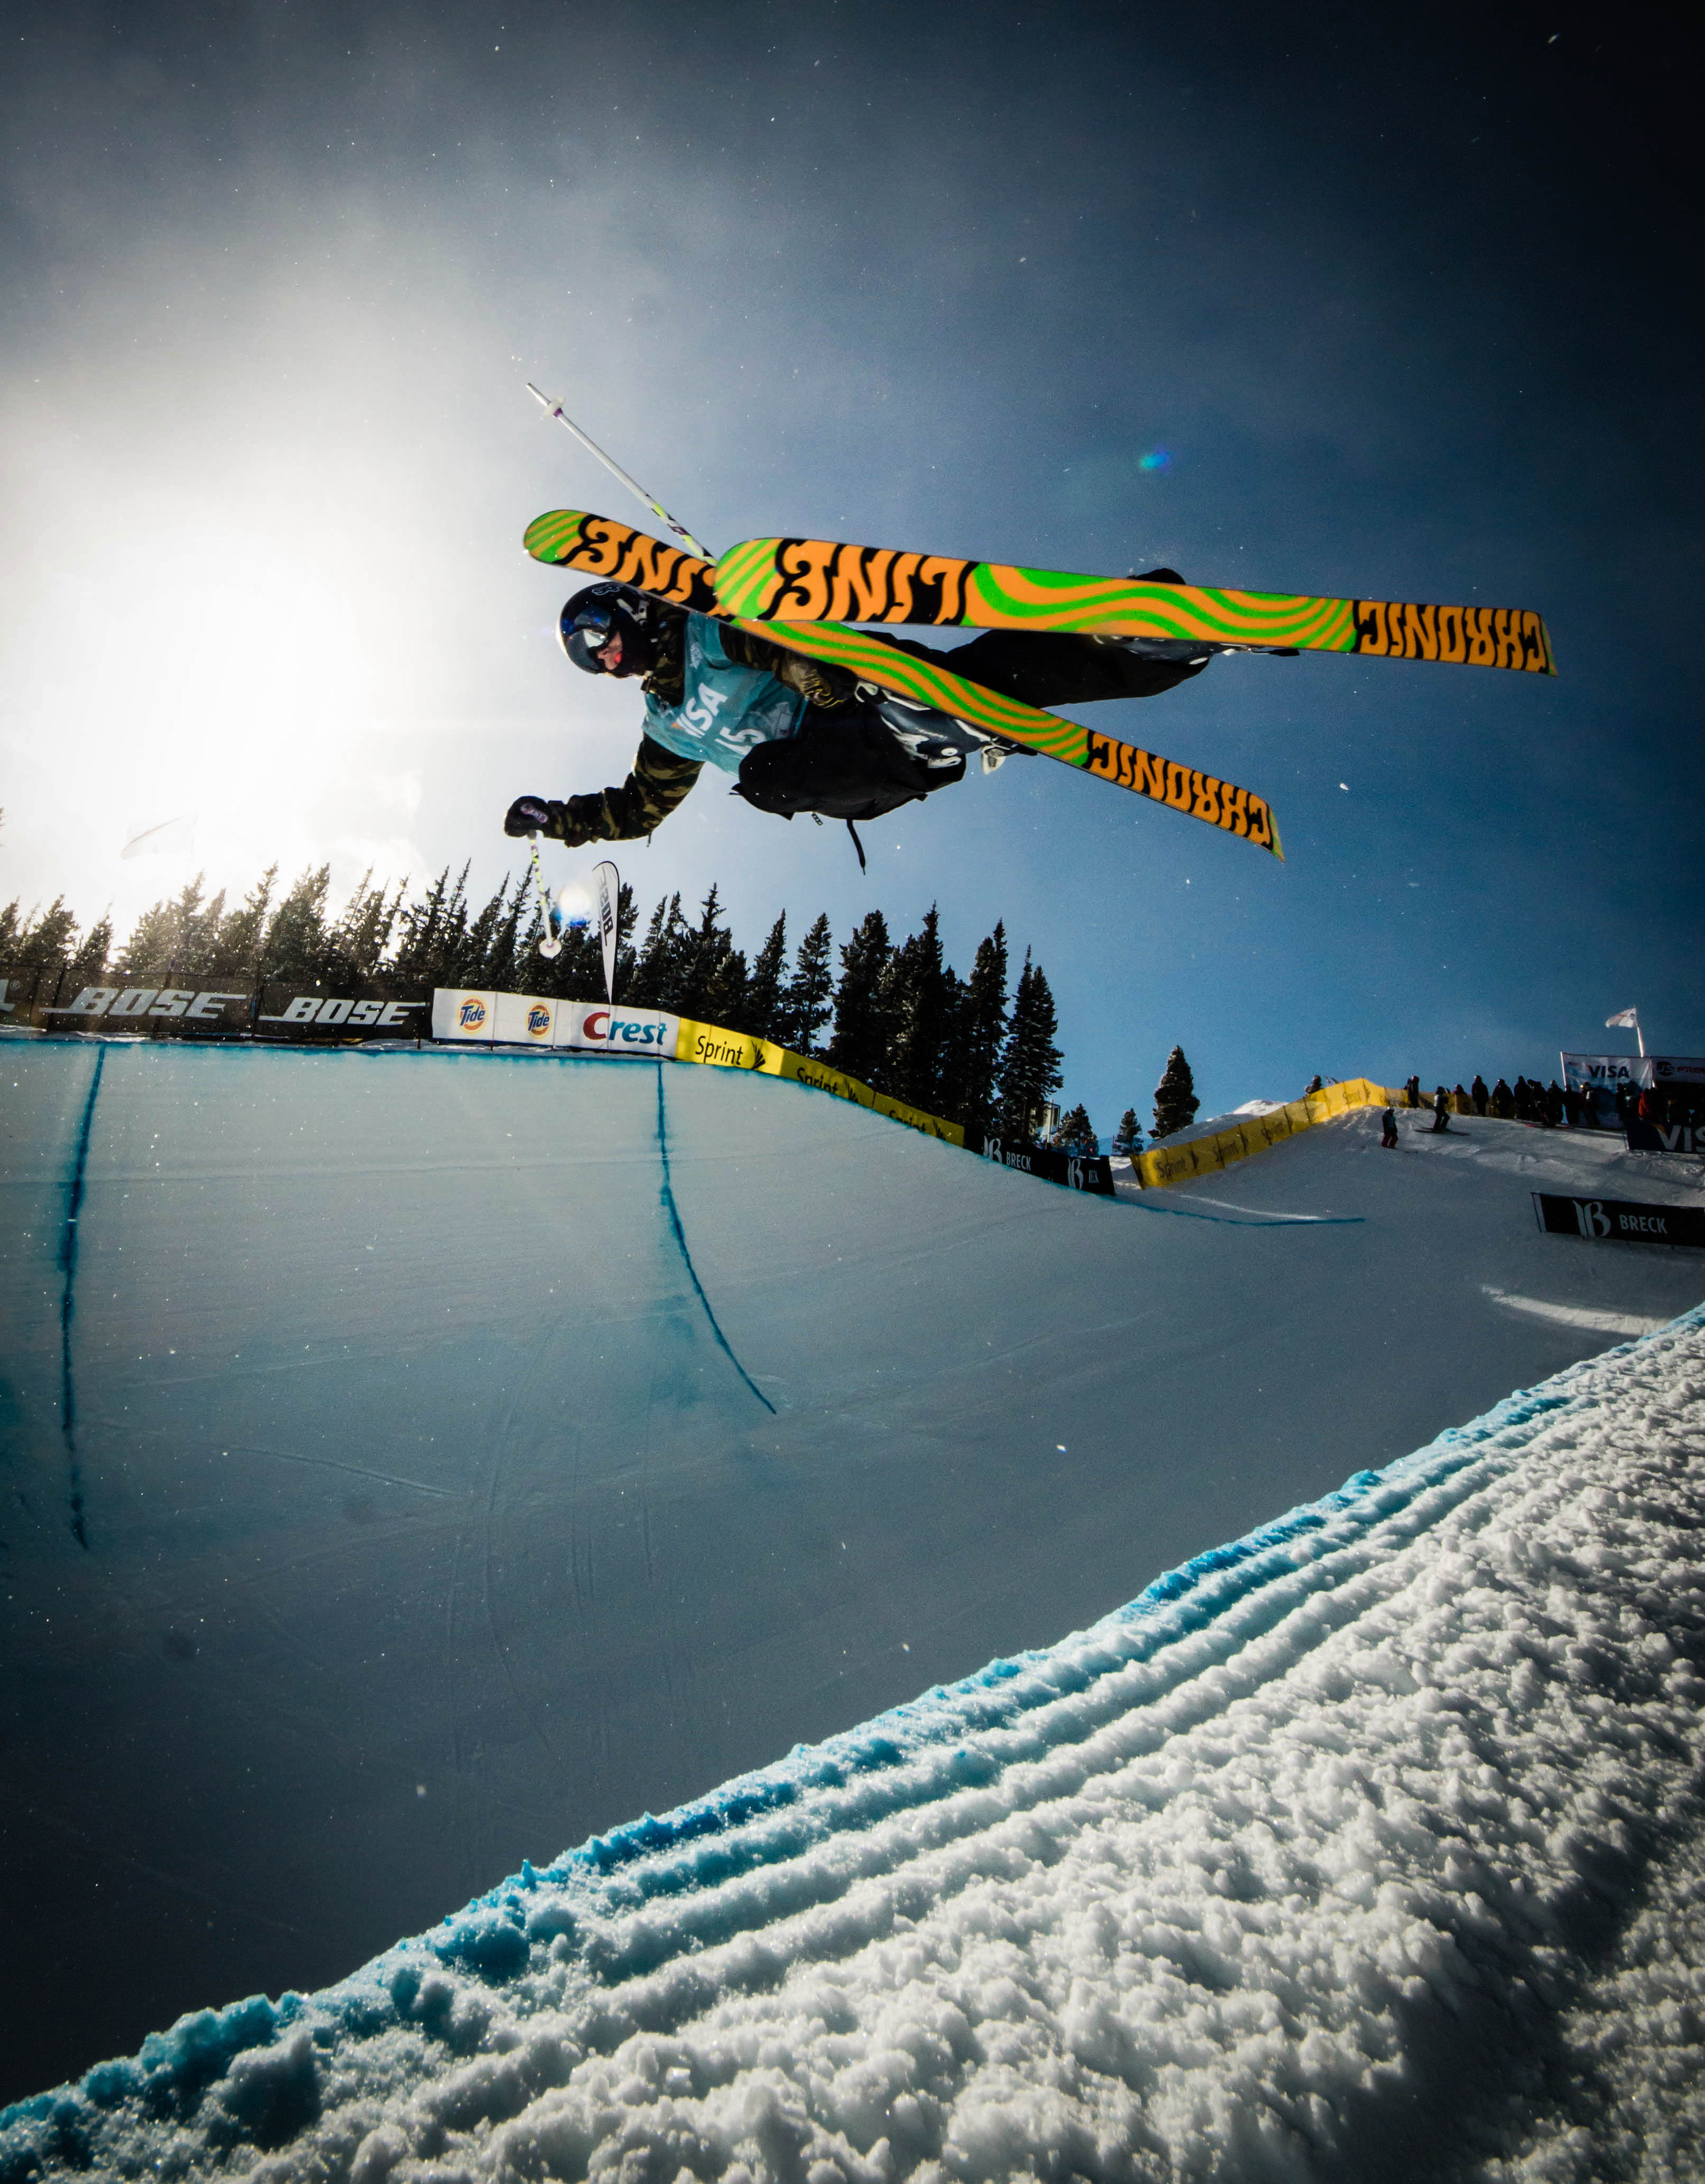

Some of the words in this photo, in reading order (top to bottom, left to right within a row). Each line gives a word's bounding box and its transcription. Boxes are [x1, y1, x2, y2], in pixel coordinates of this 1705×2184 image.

[760, 538, 969, 626] LINE
[1357, 600, 1548, 675] CHRONIC
[1087, 730, 1274, 851] CHRONIC
[39, 986, 247, 1019] BOSE
[259, 997, 426, 1025] BOSE
[459, 1005, 486, 1026] Tide
[528, 1011, 550, 1031] Tide
[583, 1012, 667, 1045] Crest
[695, 1035, 744, 1065] Sprint
[1587, 1065, 1629, 1078] VISA
[1006, 1151, 1031, 1171] BRECK
[1619, 1214, 1668, 1235] BRECK
